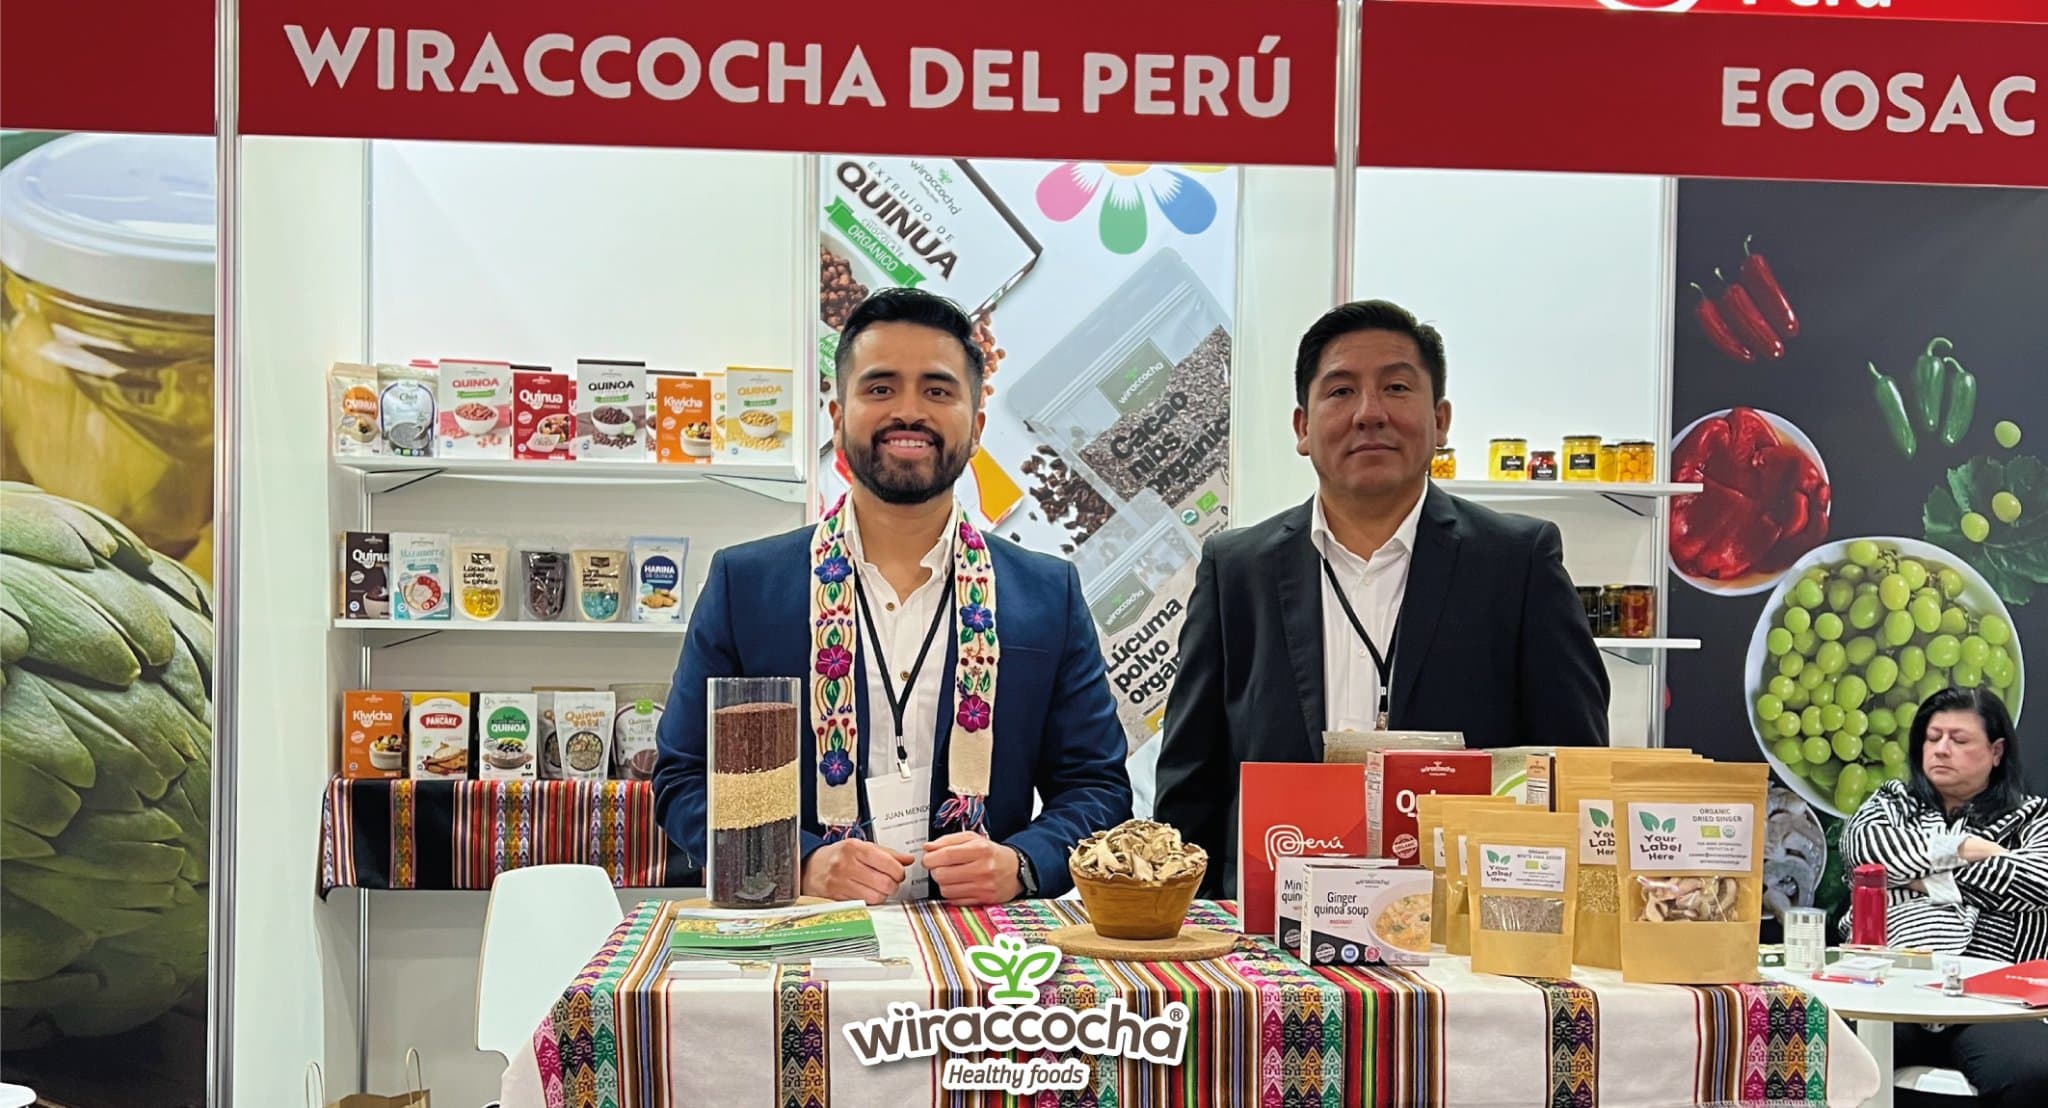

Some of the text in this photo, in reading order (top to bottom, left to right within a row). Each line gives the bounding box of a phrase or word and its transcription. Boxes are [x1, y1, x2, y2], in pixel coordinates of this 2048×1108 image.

[283, 24, 1291, 118] WIRACCOCHA DEL PERÚ
[1722, 67, 2036, 136] ECOSAC
[837, 161, 958, 281] QUINUA
[937, 225, 955, 242] DE
[452, 377, 499, 389] QUINOA
[588, 380, 634, 391] QUINOA
[1118, 361, 1164, 404] wiraccocha
[519, 389, 563, 404] Quinua
[1110, 391, 1188, 459] Cacao
[1128, 432, 1181, 480] nibs
[352, 549, 389, 563] Quinu
[1105, 598, 1184, 674] Lúcuma
[1113, 639, 1170, 694] polvo
[352, 710, 393, 721] Kiwicha
[491, 723, 527, 732] QUINOA
[1588, 837, 1616, 848] Lab
[1644, 835, 1677, 843] Your
[1264, 824, 1345, 872] Perú
[1596, 848, 1616, 856] Her
[1640, 843, 1682, 853] Label
[1648, 852, 1675, 861] Here
[1486, 870, 1513, 878] Label
[1327, 891, 1358, 907] Ginger
[1313, 904, 1369, 918] quinoa soup
